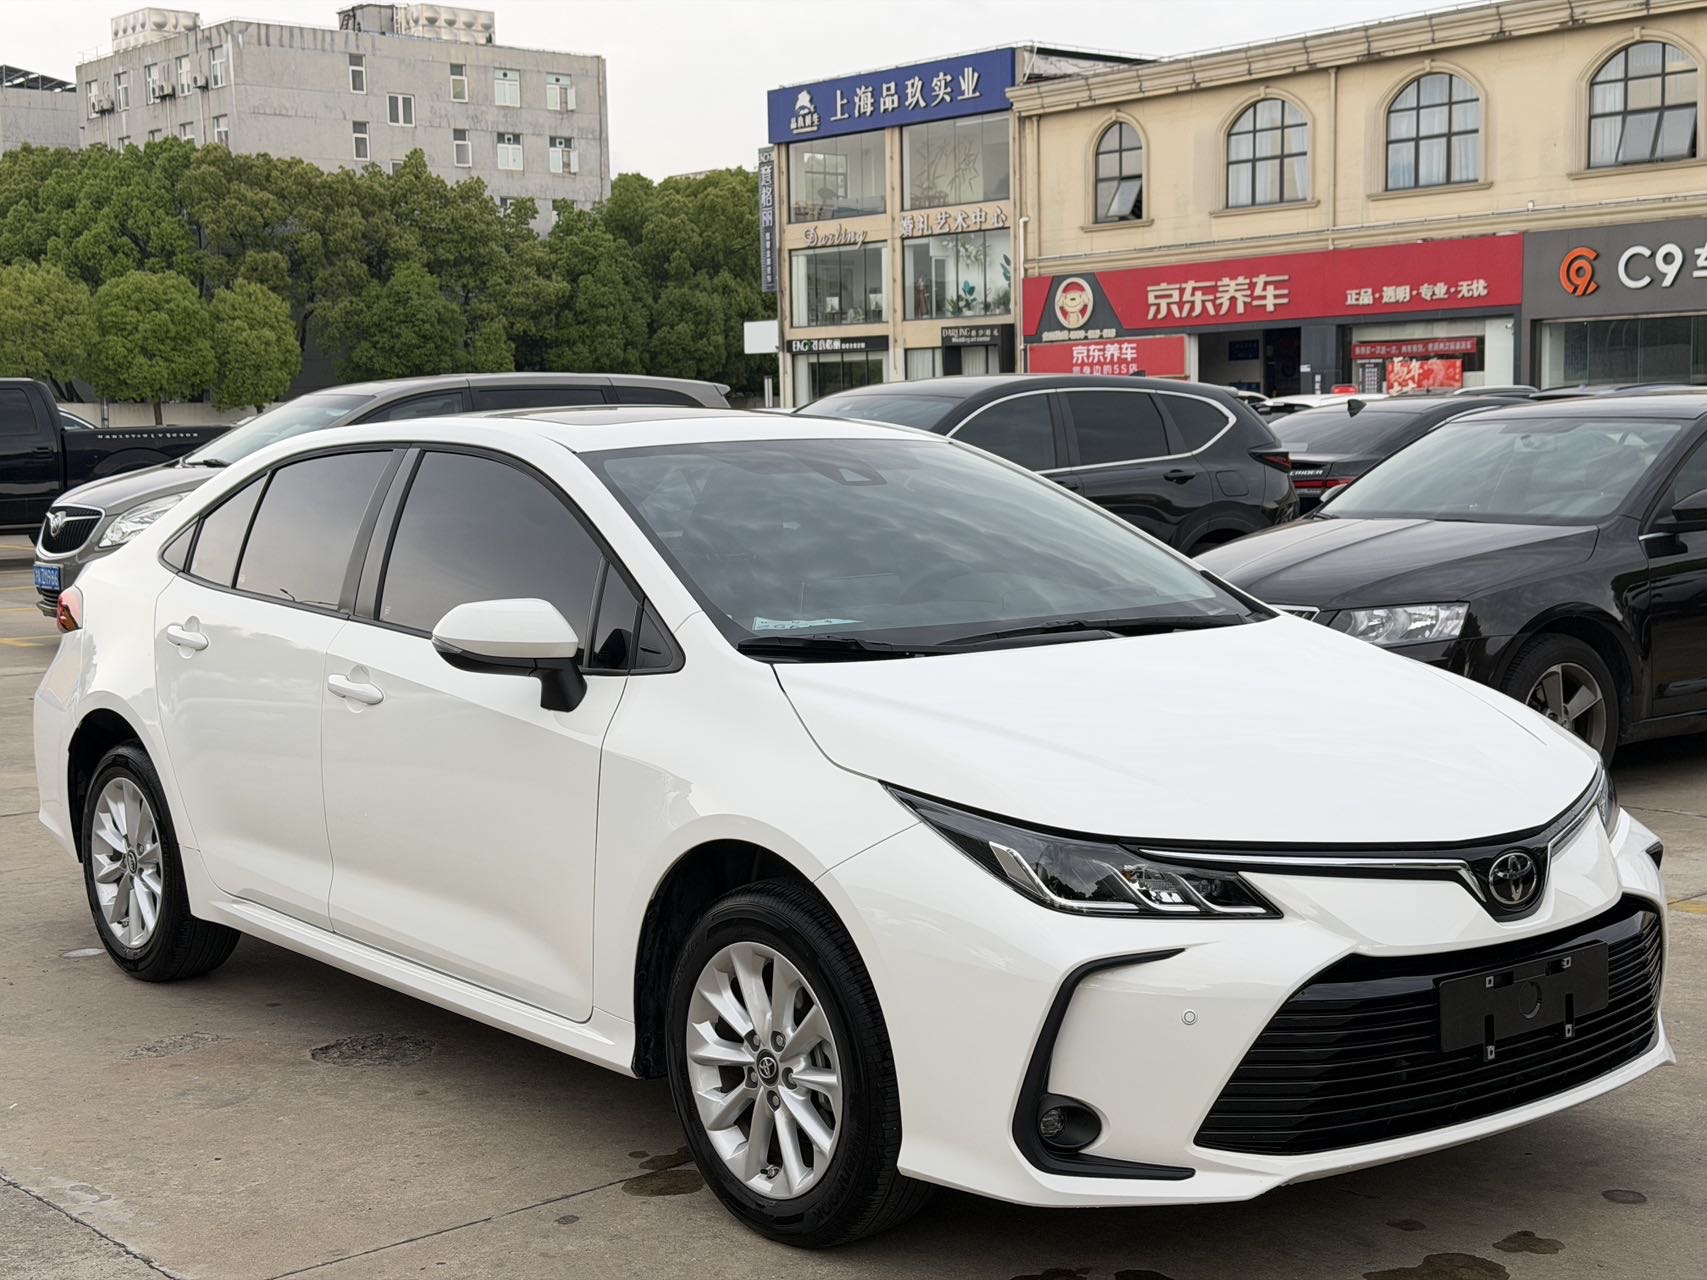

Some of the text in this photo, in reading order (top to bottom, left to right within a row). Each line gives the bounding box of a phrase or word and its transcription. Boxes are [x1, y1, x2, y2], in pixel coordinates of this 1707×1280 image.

[830, 66, 980, 122] 上海品玖实业
[804, 223, 868, 250] Darling
[900, 205, 1008, 238] 婚礼艺术中心
[1146, 273, 1290, 321] 京东养车
[1071, 342, 1138, 364] 京东养车
